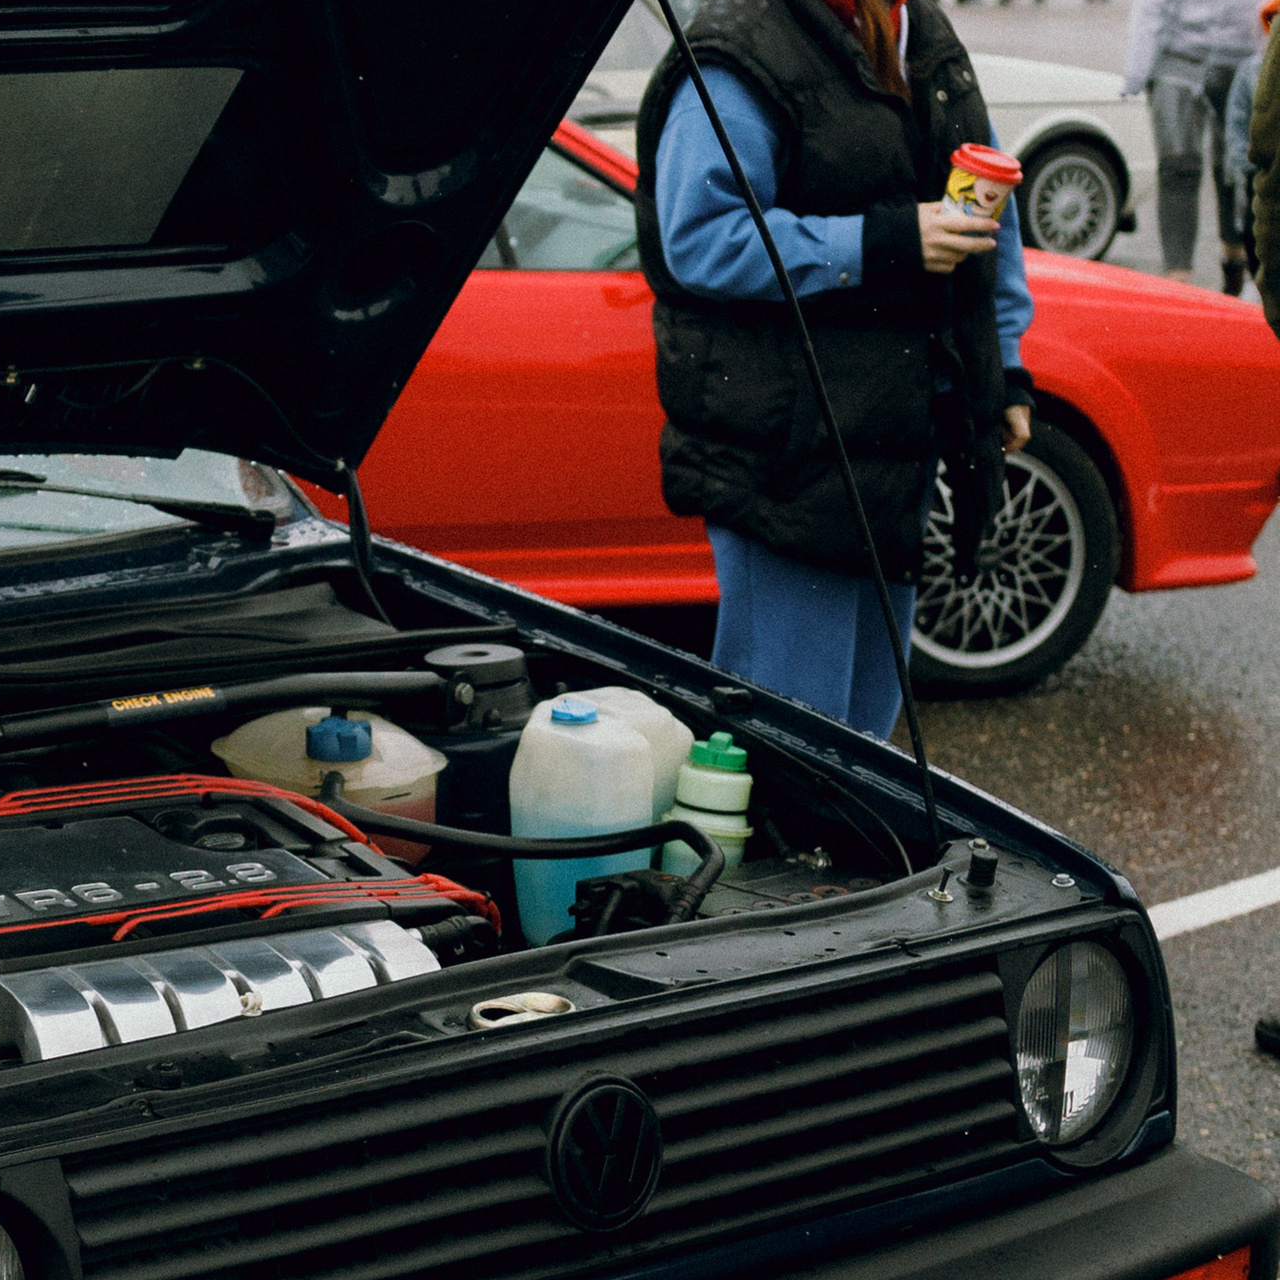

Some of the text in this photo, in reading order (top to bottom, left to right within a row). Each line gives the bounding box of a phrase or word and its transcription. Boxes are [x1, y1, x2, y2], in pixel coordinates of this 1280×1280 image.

[111, 686, 216, 711] CHECK ENGINE
[170, 861, 278, 891] 2.8
